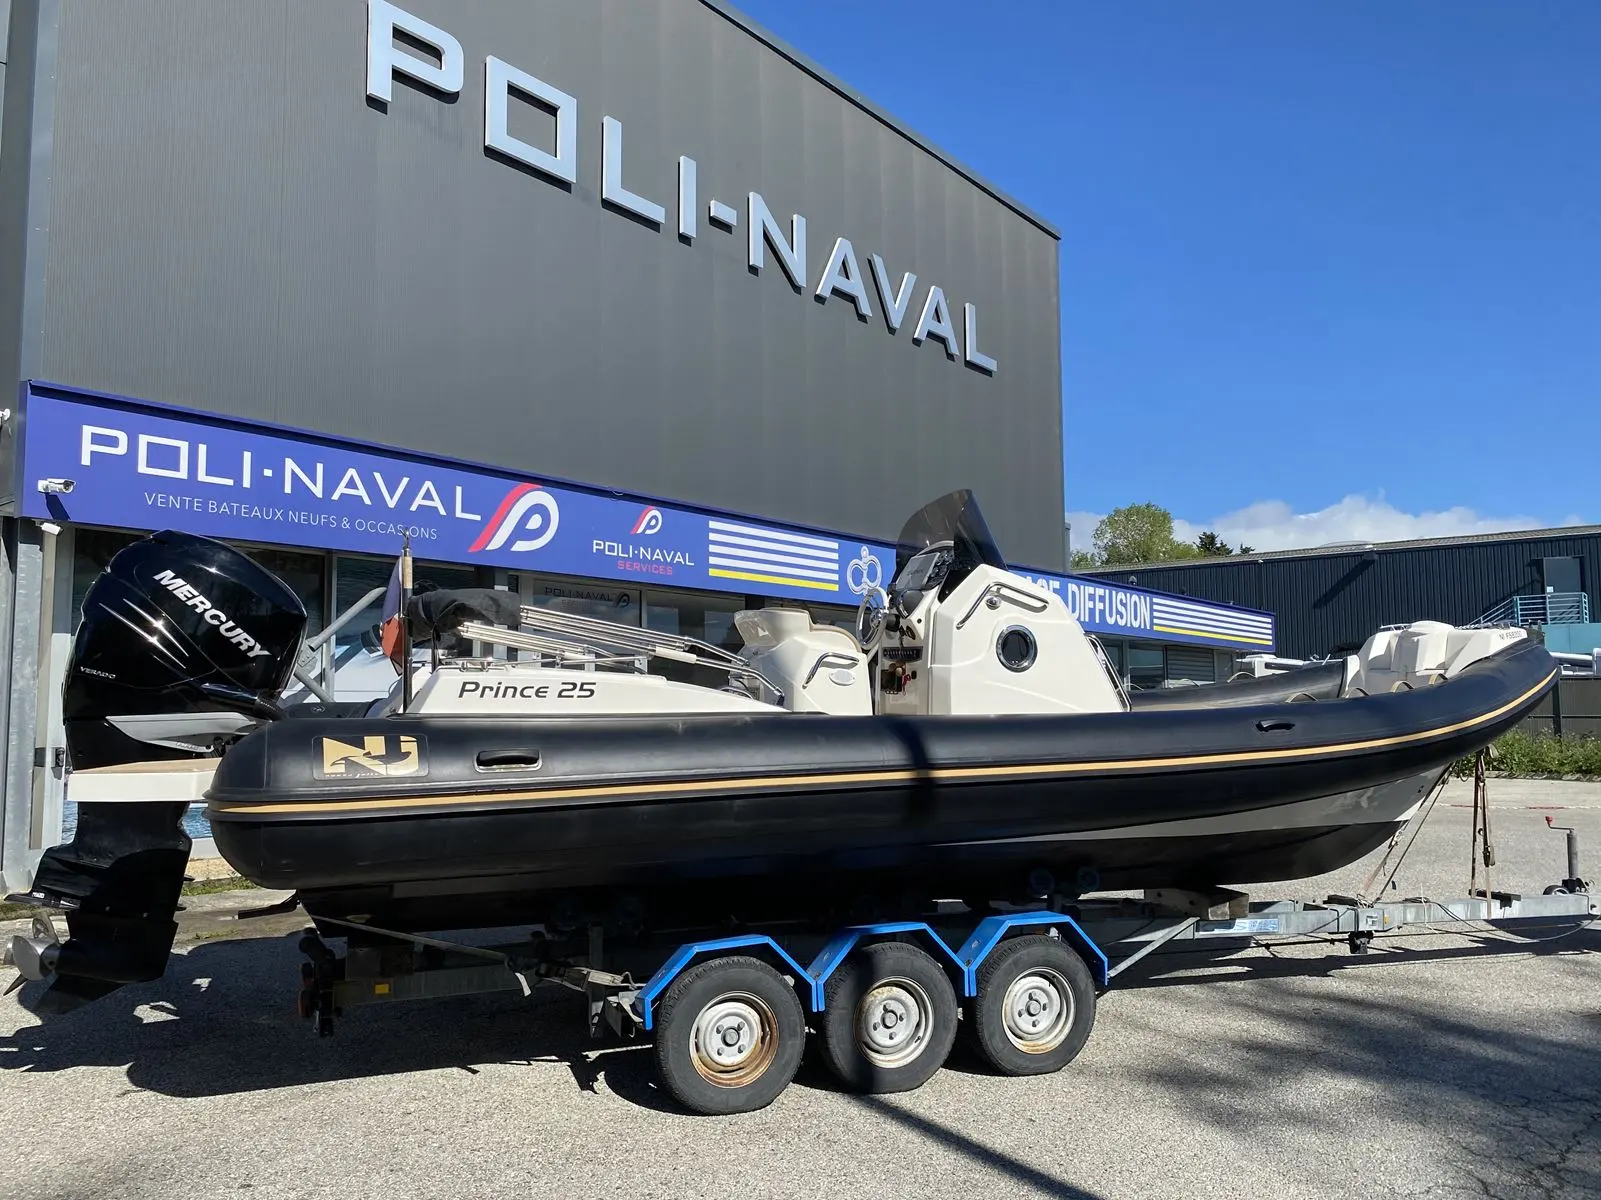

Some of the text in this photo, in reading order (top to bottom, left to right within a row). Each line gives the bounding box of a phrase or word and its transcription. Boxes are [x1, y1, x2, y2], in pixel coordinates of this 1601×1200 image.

[366, 0, 998, 372] POLI-NAVAL
[144, 491, 203, 512] VENTE
[208, 500, 284, 522] BATEAUX
[288, 510, 337, 528] NEUFS
[341, 516, 351, 530] &
[617, 560, 673, 576] SERVICES
[153, 568, 272, 659] MERCURY
[1067, 582, 1151, 630] DIFFUSION
[80, 666, 117, 680] VERADO
[458, 681, 597, 699] Prince 25
